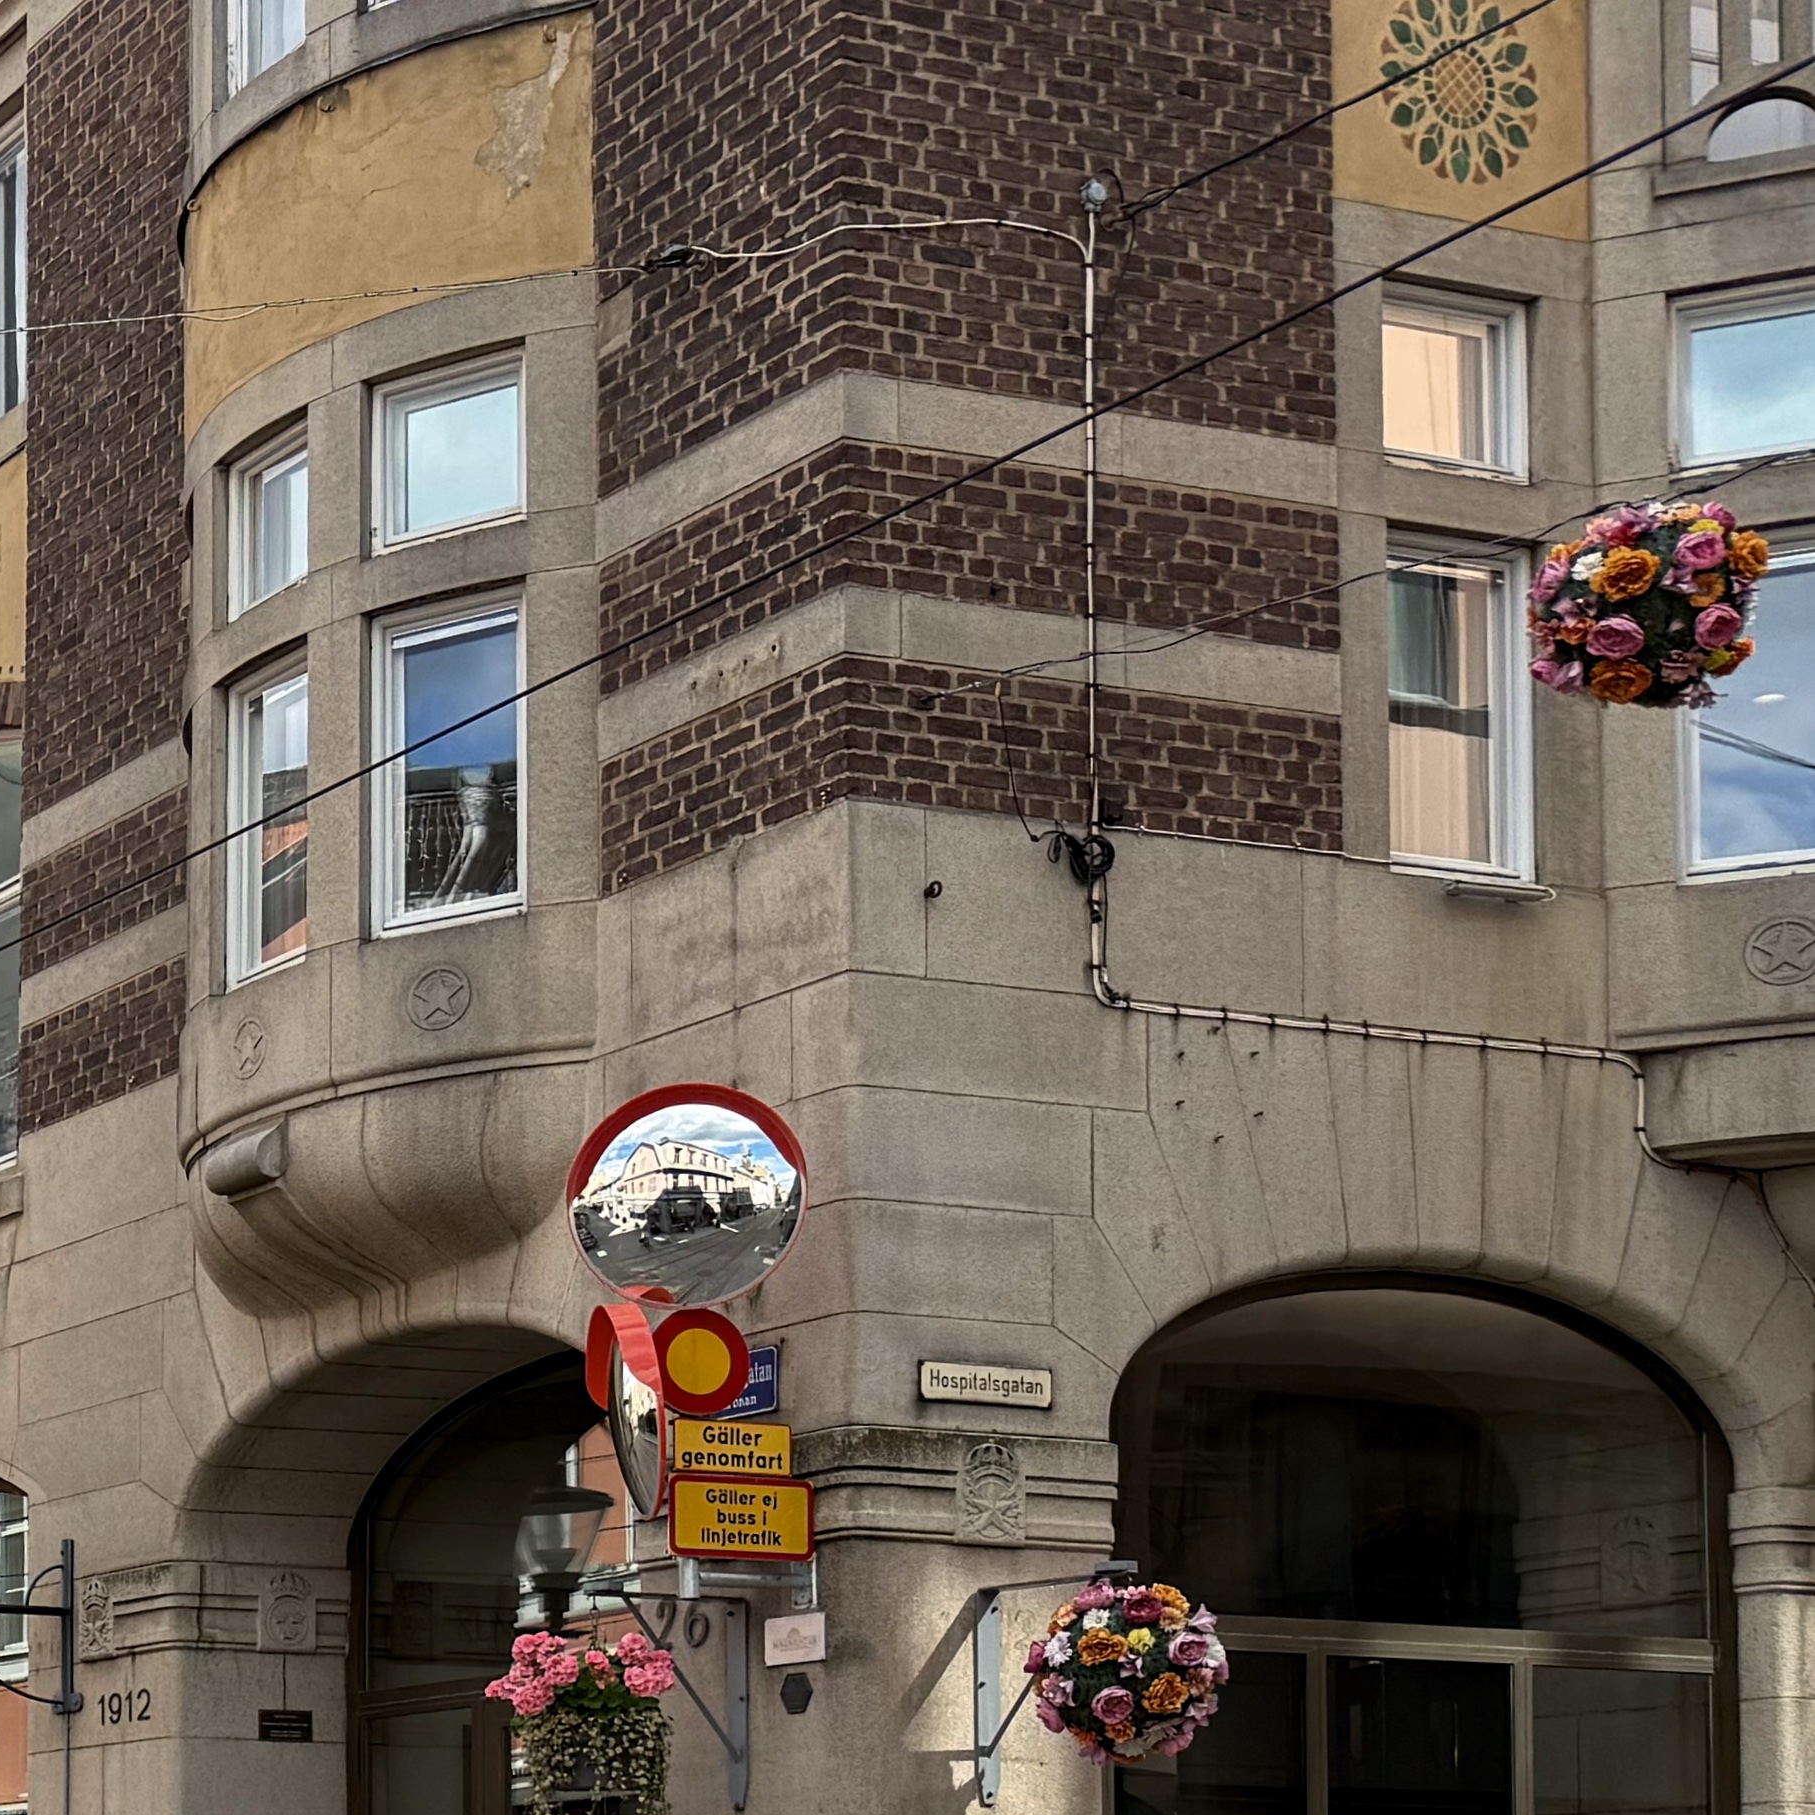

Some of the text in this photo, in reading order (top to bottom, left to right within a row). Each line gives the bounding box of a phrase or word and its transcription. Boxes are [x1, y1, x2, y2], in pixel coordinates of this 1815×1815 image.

[929, 1368, 1043, 1398] Hospitalsgatan
[702, 1425, 763, 1447] Gäller
[681, 1450, 784, 1471] genomfart
[705, 1488, 778, 1510] Gäller ej
[716, 1508, 768, 1526] buss i
[700, 1526, 783, 1547] linjetrafik
[656, 1601, 711, 1648] 26
[97, 1687, 151, 1727] 1912
